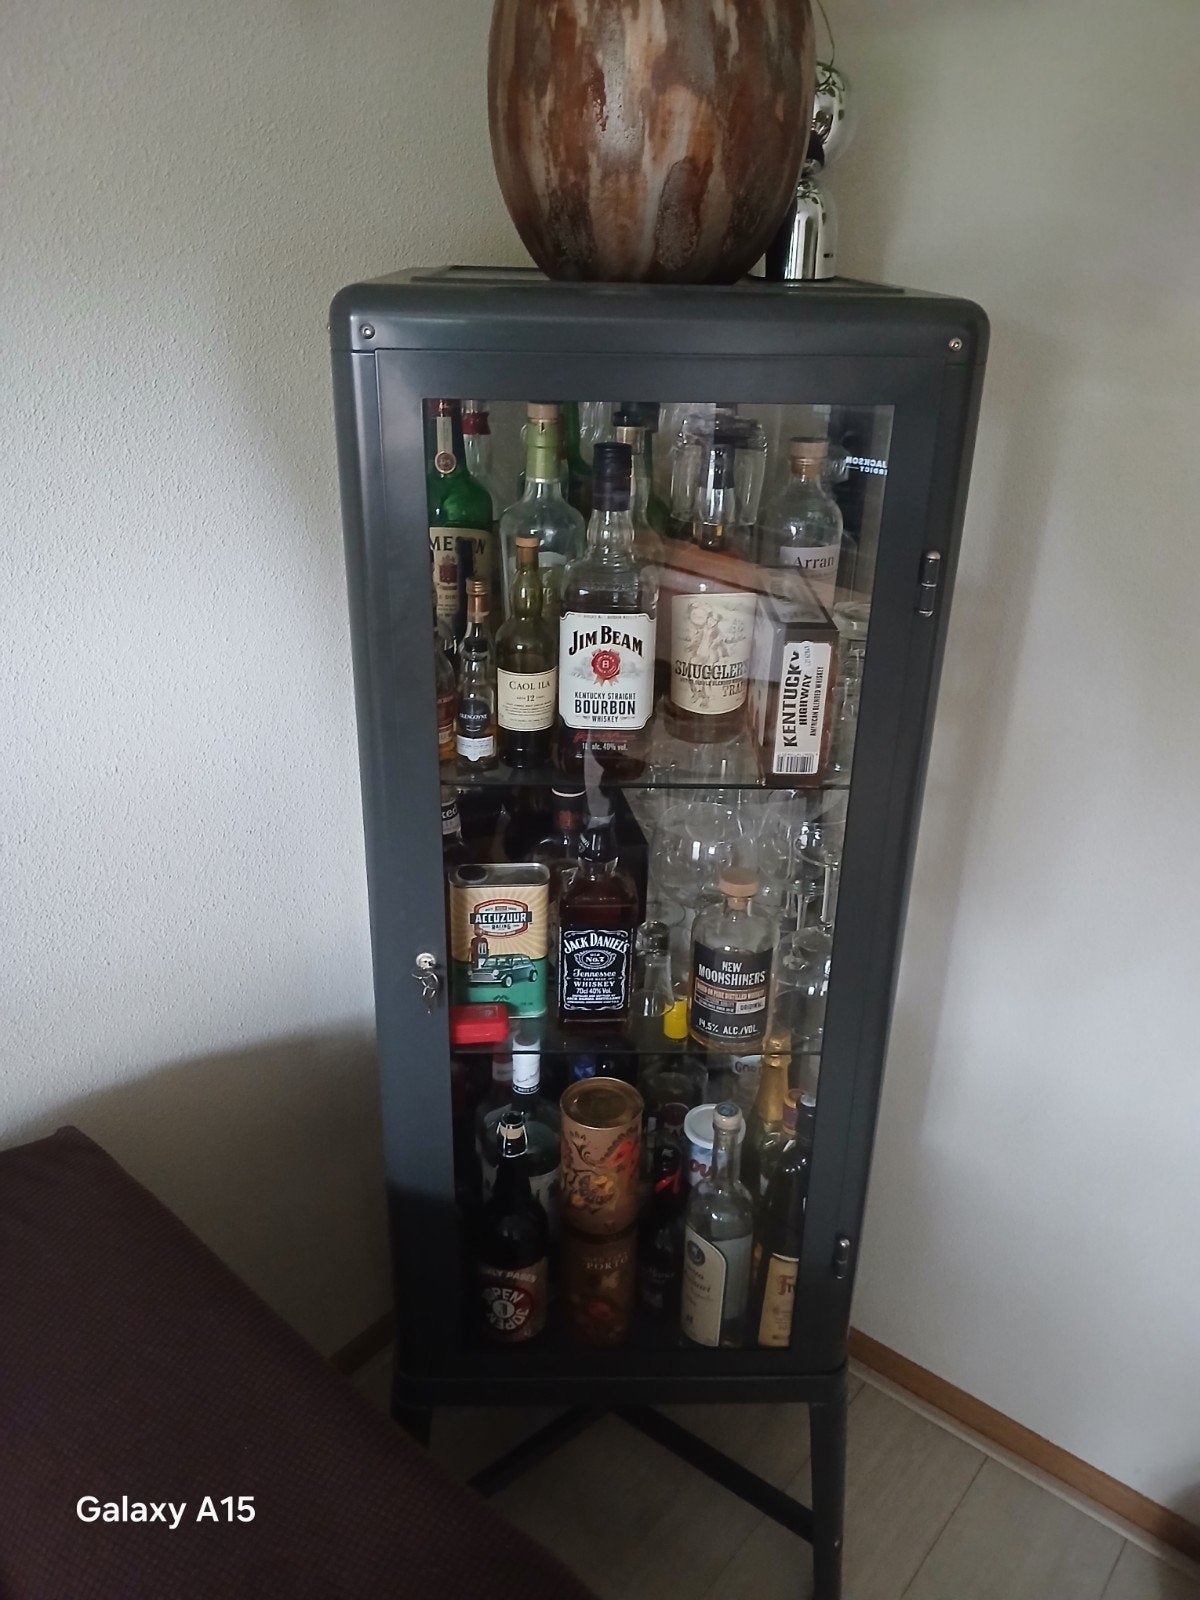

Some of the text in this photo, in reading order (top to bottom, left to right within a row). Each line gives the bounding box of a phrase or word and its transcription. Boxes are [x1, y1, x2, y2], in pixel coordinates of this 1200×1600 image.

[794, 556, 835, 569] Arran
[568, 625, 644, 658] JIM BEAM
[508, 680, 536, 691] CAOL
[526, 694, 536, 702] 12
[574, 691, 636, 700] KENTUCKY STRAIGHT
[798, 674, 812, 726] HIGHWAY
[574, 699, 636, 715] BOURBON
[592, 715, 619, 723] WHISKEY
[474, 912, 527, 924] ACCUZUUR
[564, 936, 590, 954] JACK
[573, 968, 617, 977] Tennessee
[722, 961, 742, 972] NEW
[698, 963, 766, 986] MOONSHINERS
